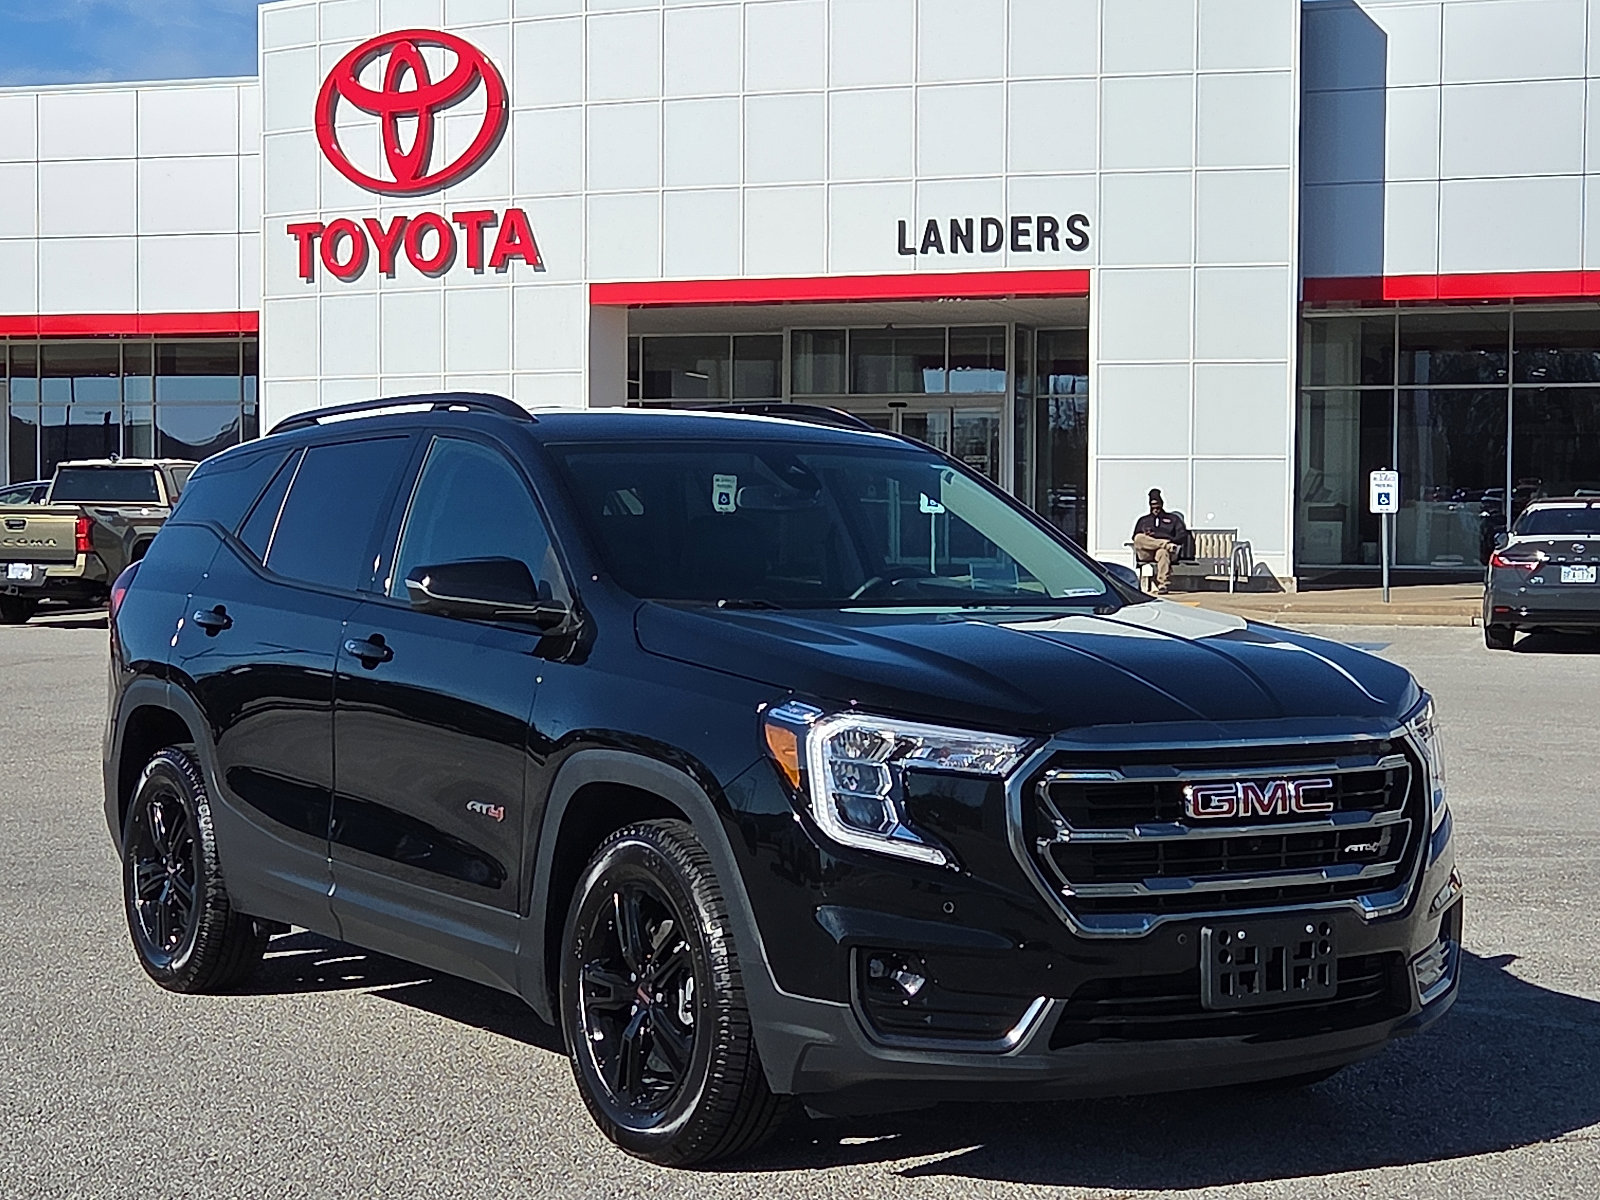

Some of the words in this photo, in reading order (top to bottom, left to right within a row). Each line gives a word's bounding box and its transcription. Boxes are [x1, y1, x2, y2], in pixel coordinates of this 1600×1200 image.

[287, 208, 546, 283] TOYOTA
[898, 214, 1090, 255] LANDERS
[0, 538, 57, 547] COMA
[1184, 778, 1334, 818] GMC
